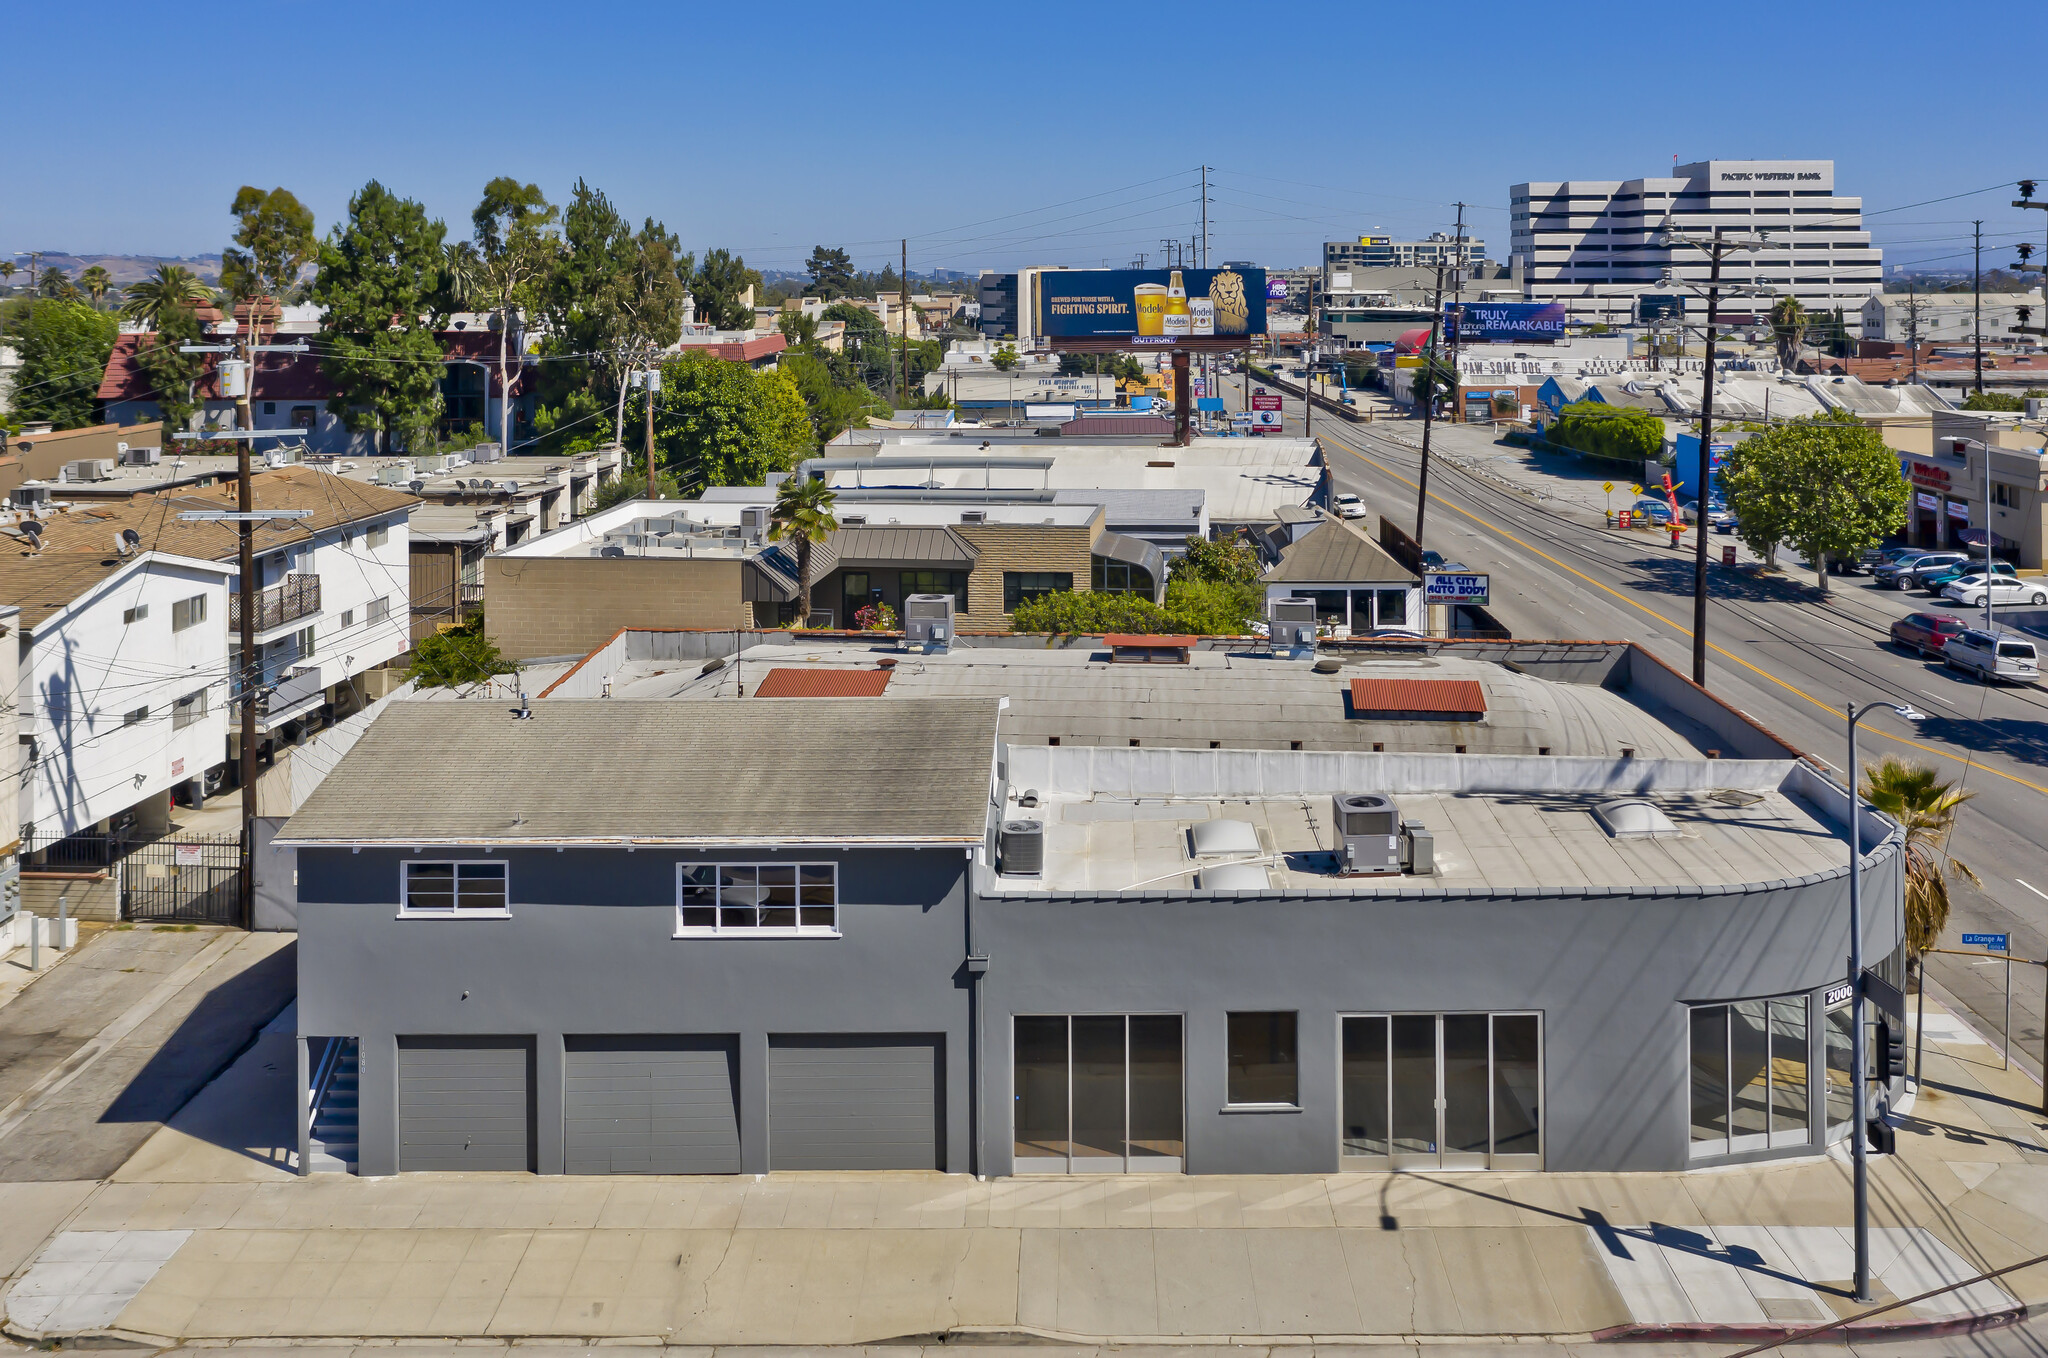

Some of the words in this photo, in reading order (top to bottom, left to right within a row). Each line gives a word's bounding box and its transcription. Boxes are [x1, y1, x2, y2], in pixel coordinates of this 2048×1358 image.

[1721, 172, 1753, 181] PACIFIC
[1754, 172, 1795, 181] WESTERN
[1797, 172, 1822, 181] BANK
[1051, 304, 1095, 315] FIGHTING
[1096, 303, 1130, 314] SPIRIT.
[1137, 303, 1164, 314] Modelo
[1474, 310, 1508, 320] TRULY
[1166, 317, 1187, 326] Modelo
[1486, 320, 1563, 331] REMARKABLE
[1463, 361, 1518, 375] PAW-SOME
[1521, 361, 1541, 375] DOG
[1435, 575, 1454, 585] ALL
[1456, 576, 1478, 586] CITY
[1427, 585, 1455, 594] AUTO
[1458, 586, 1486, 596] BODY
[1973, 935, 1995, 944] Grange
[1828, 985, 1853, 1004] 2000
